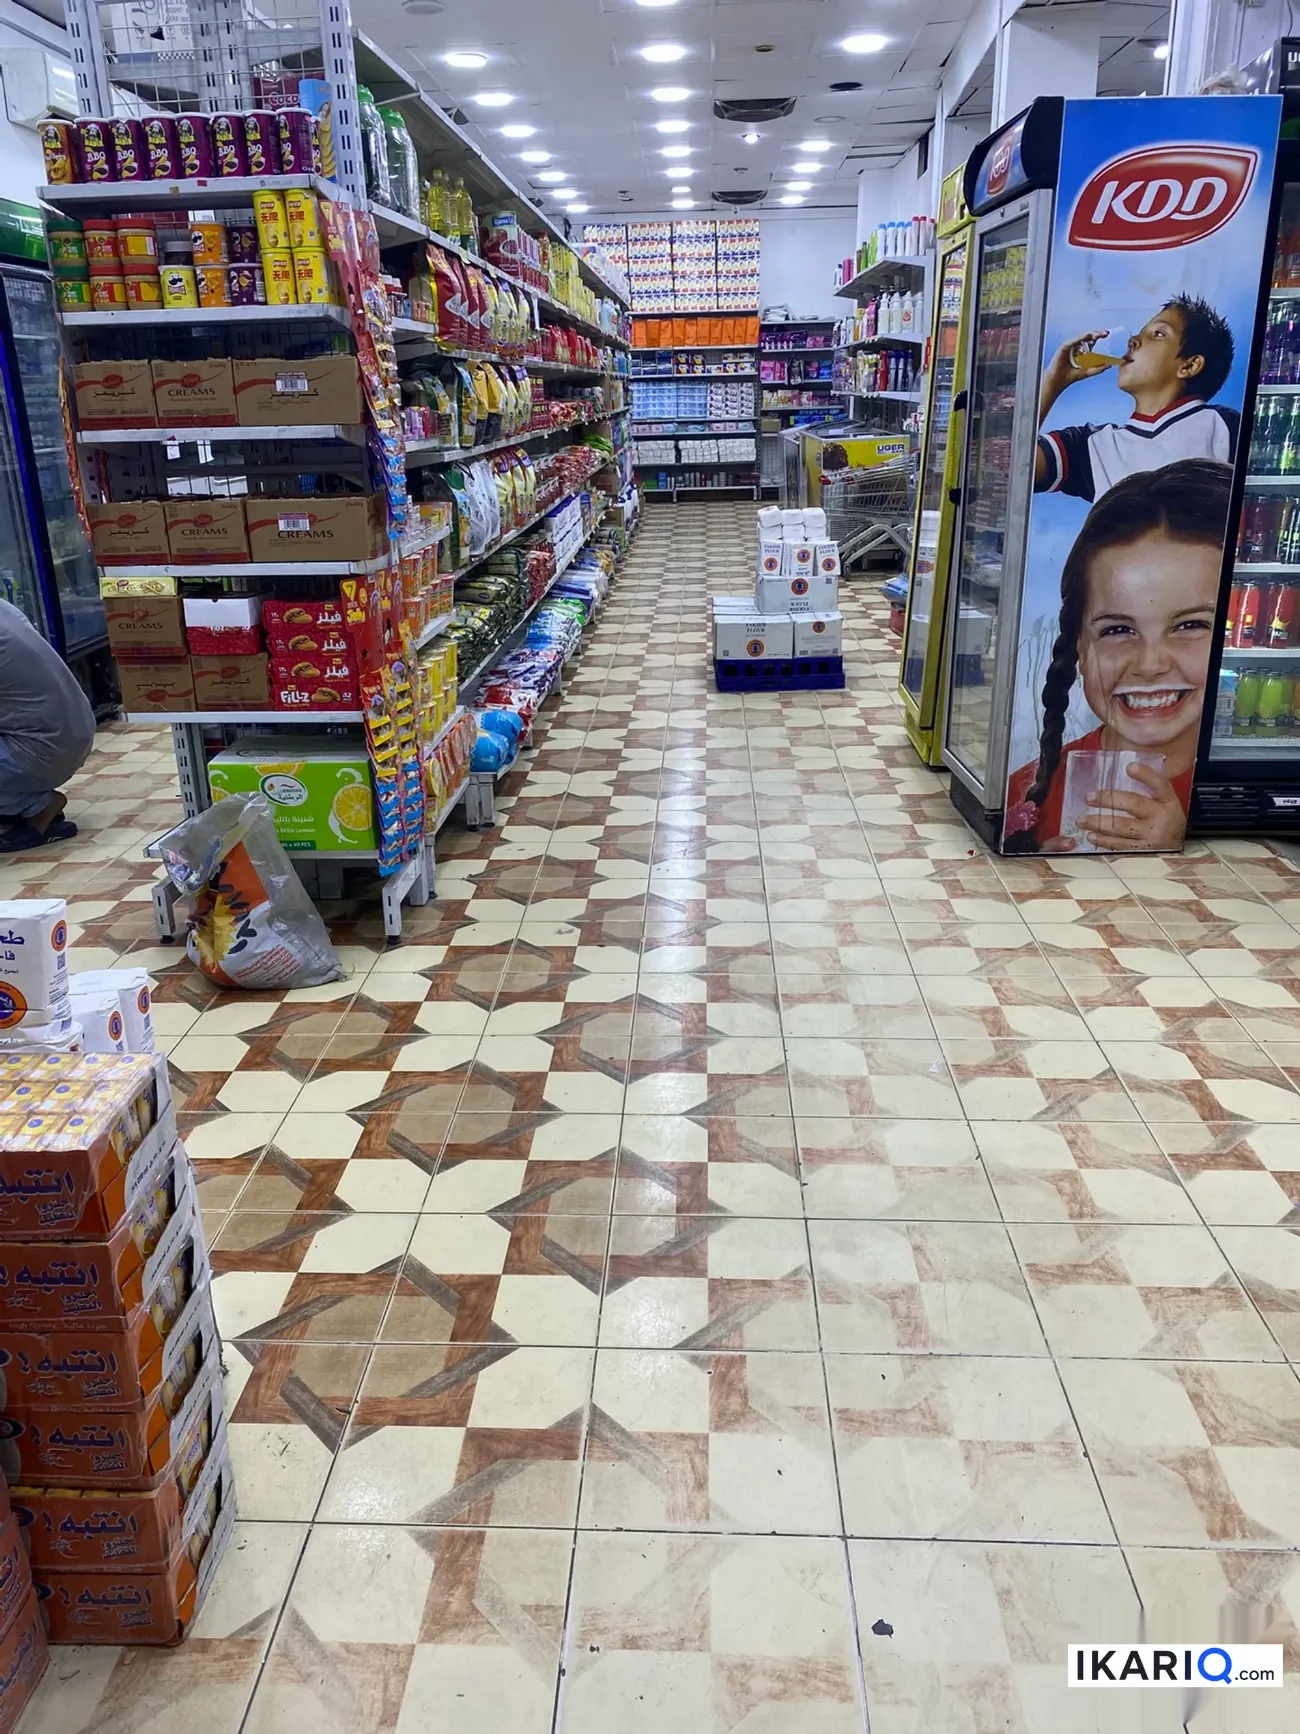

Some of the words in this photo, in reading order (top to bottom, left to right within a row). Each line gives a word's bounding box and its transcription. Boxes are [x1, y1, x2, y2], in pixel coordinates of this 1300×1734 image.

[1091, 177, 1228, 224] KDD
[168, 388, 216, 397] CREAMS
[181, 528, 228, 536] CREAMS
[277, 530, 334, 538] CREAMS
[317, 611, 342, 624] فيلز
[118, 622, 163, 630] CREAMS
[322, 639, 347, 652] فيلز
[324, 665, 349, 678] فيلز
